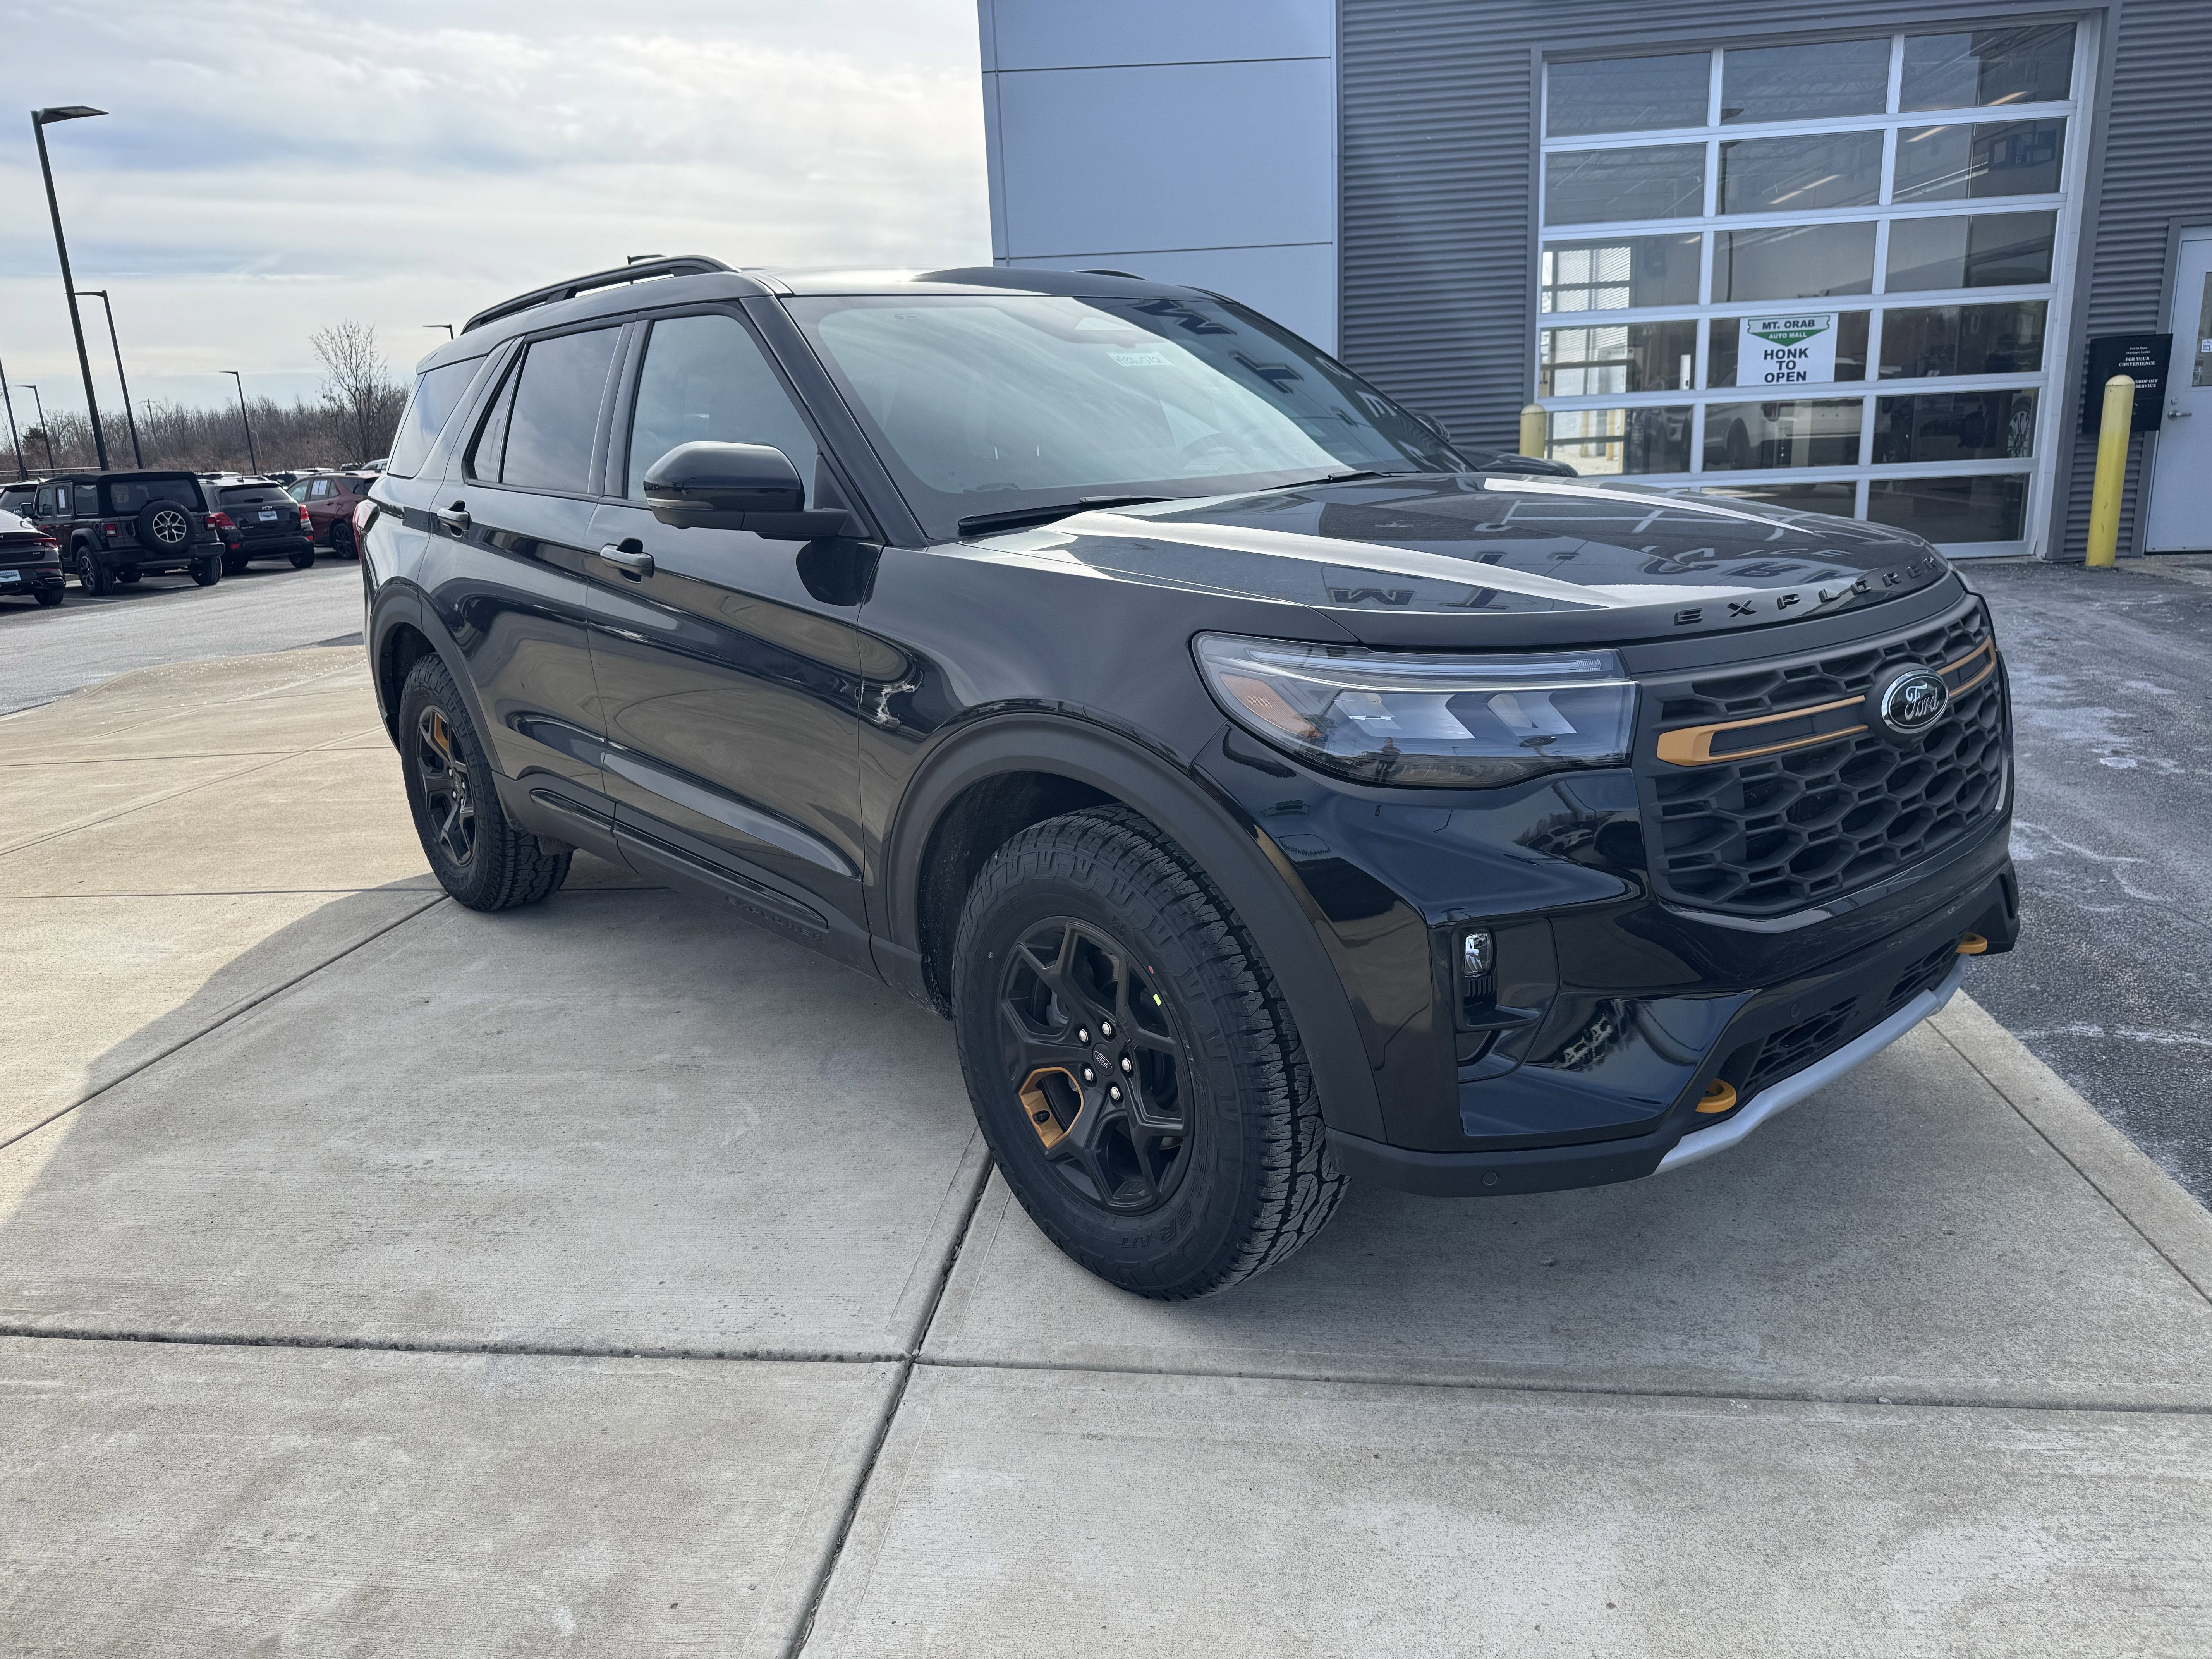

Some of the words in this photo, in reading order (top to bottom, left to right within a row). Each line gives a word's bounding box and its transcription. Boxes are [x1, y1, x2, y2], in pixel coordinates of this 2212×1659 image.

[1762, 321, 1780, 330] MT.
[1784, 320, 1815, 328] ORAB
[1764, 347, 1809, 360] HONK
[1776, 360, 1796, 371] TO
[1764, 371, 1807, 383] OPEN
[1674, 556, 1937, 626] EXPLORER
[1905, 682, 1939, 721] Ford
[726, 896, 826, 944] EXPLORER
[1096, 1054, 1109, 1067] Ford
